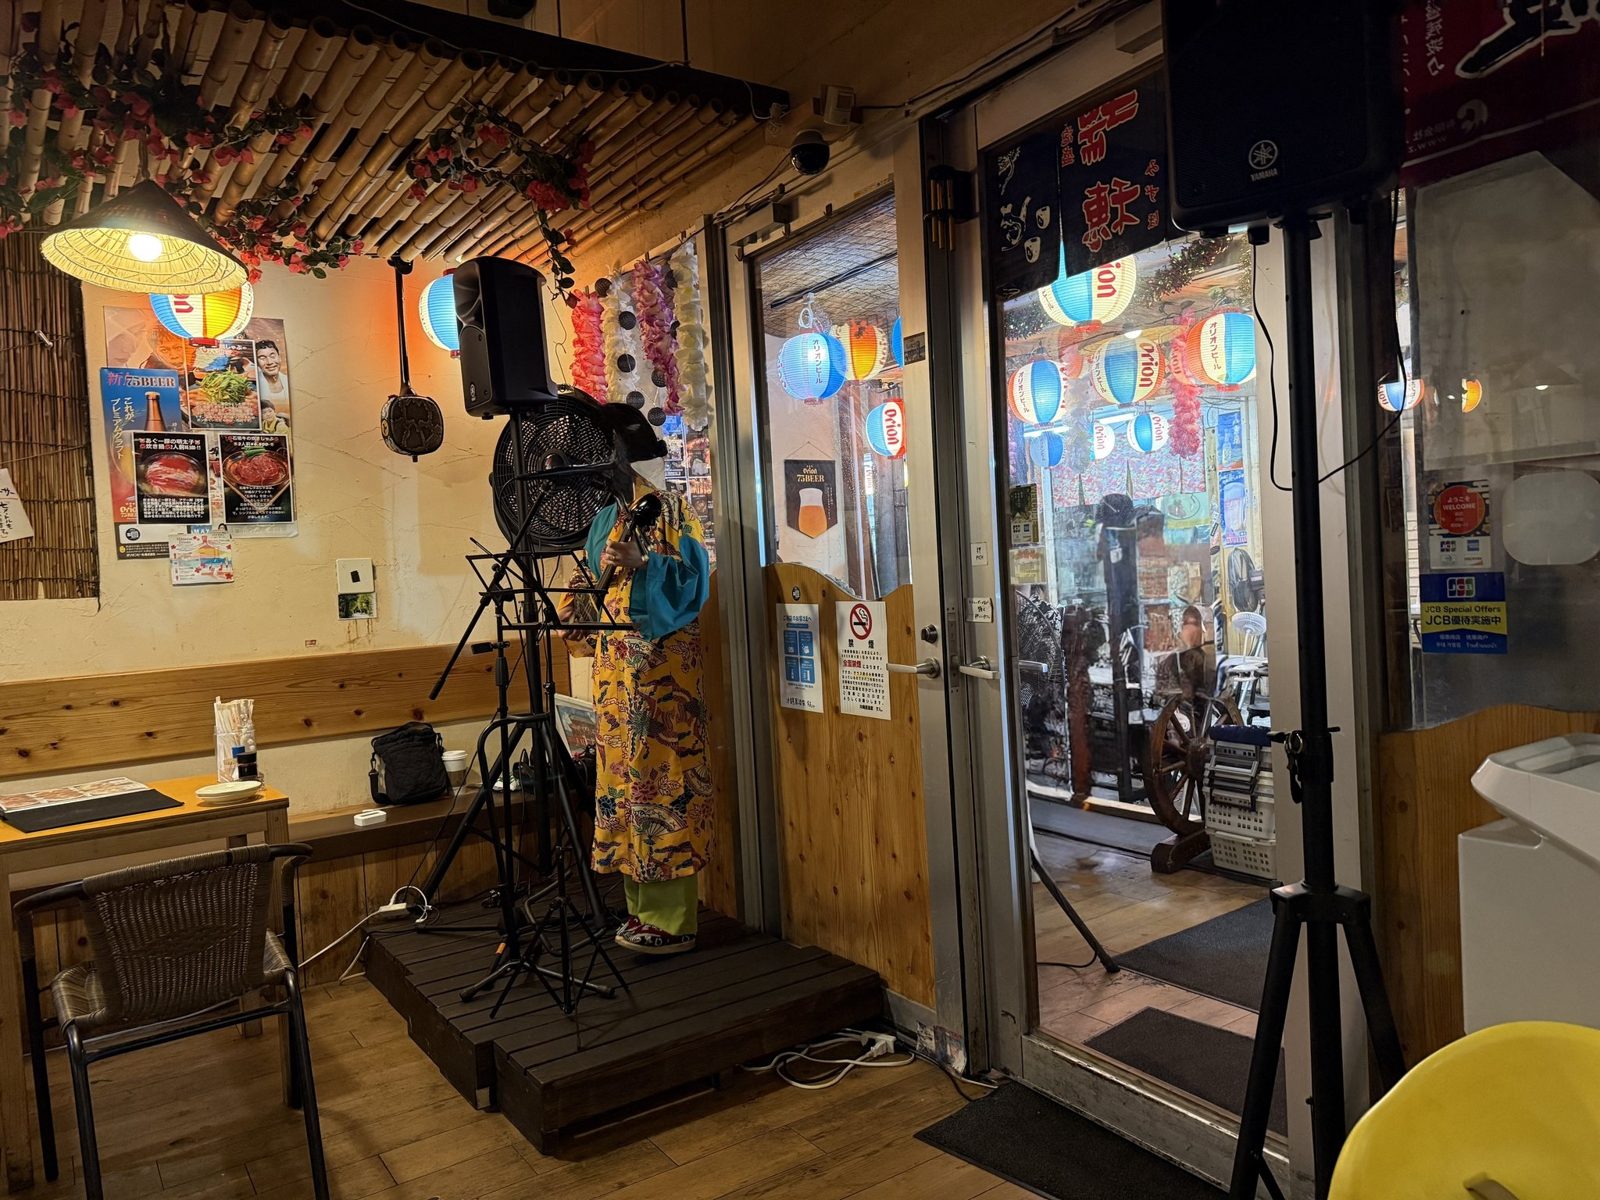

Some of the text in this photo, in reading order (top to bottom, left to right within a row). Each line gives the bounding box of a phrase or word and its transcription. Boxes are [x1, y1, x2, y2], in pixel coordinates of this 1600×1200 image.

[1097, 262, 1121, 298] ion
[1209, 321, 1222, 370] オリオンビール
[812, 339, 824, 384] オリオンビール
[125, 375, 177, 387] 75BEER
[1017, 371, 1030, 414] オリオンビール
[884, 408, 901, 446] Orion
[797, 475, 825, 483] 75BEER
[1447, 495, 1471, 503] ようこそ
[1442, 503, 1477, 511] WELCOME
[1425, 605, 1501, 614] JCB Special Offers
[1425, 615, 1501, 626] JCB優待実施中
